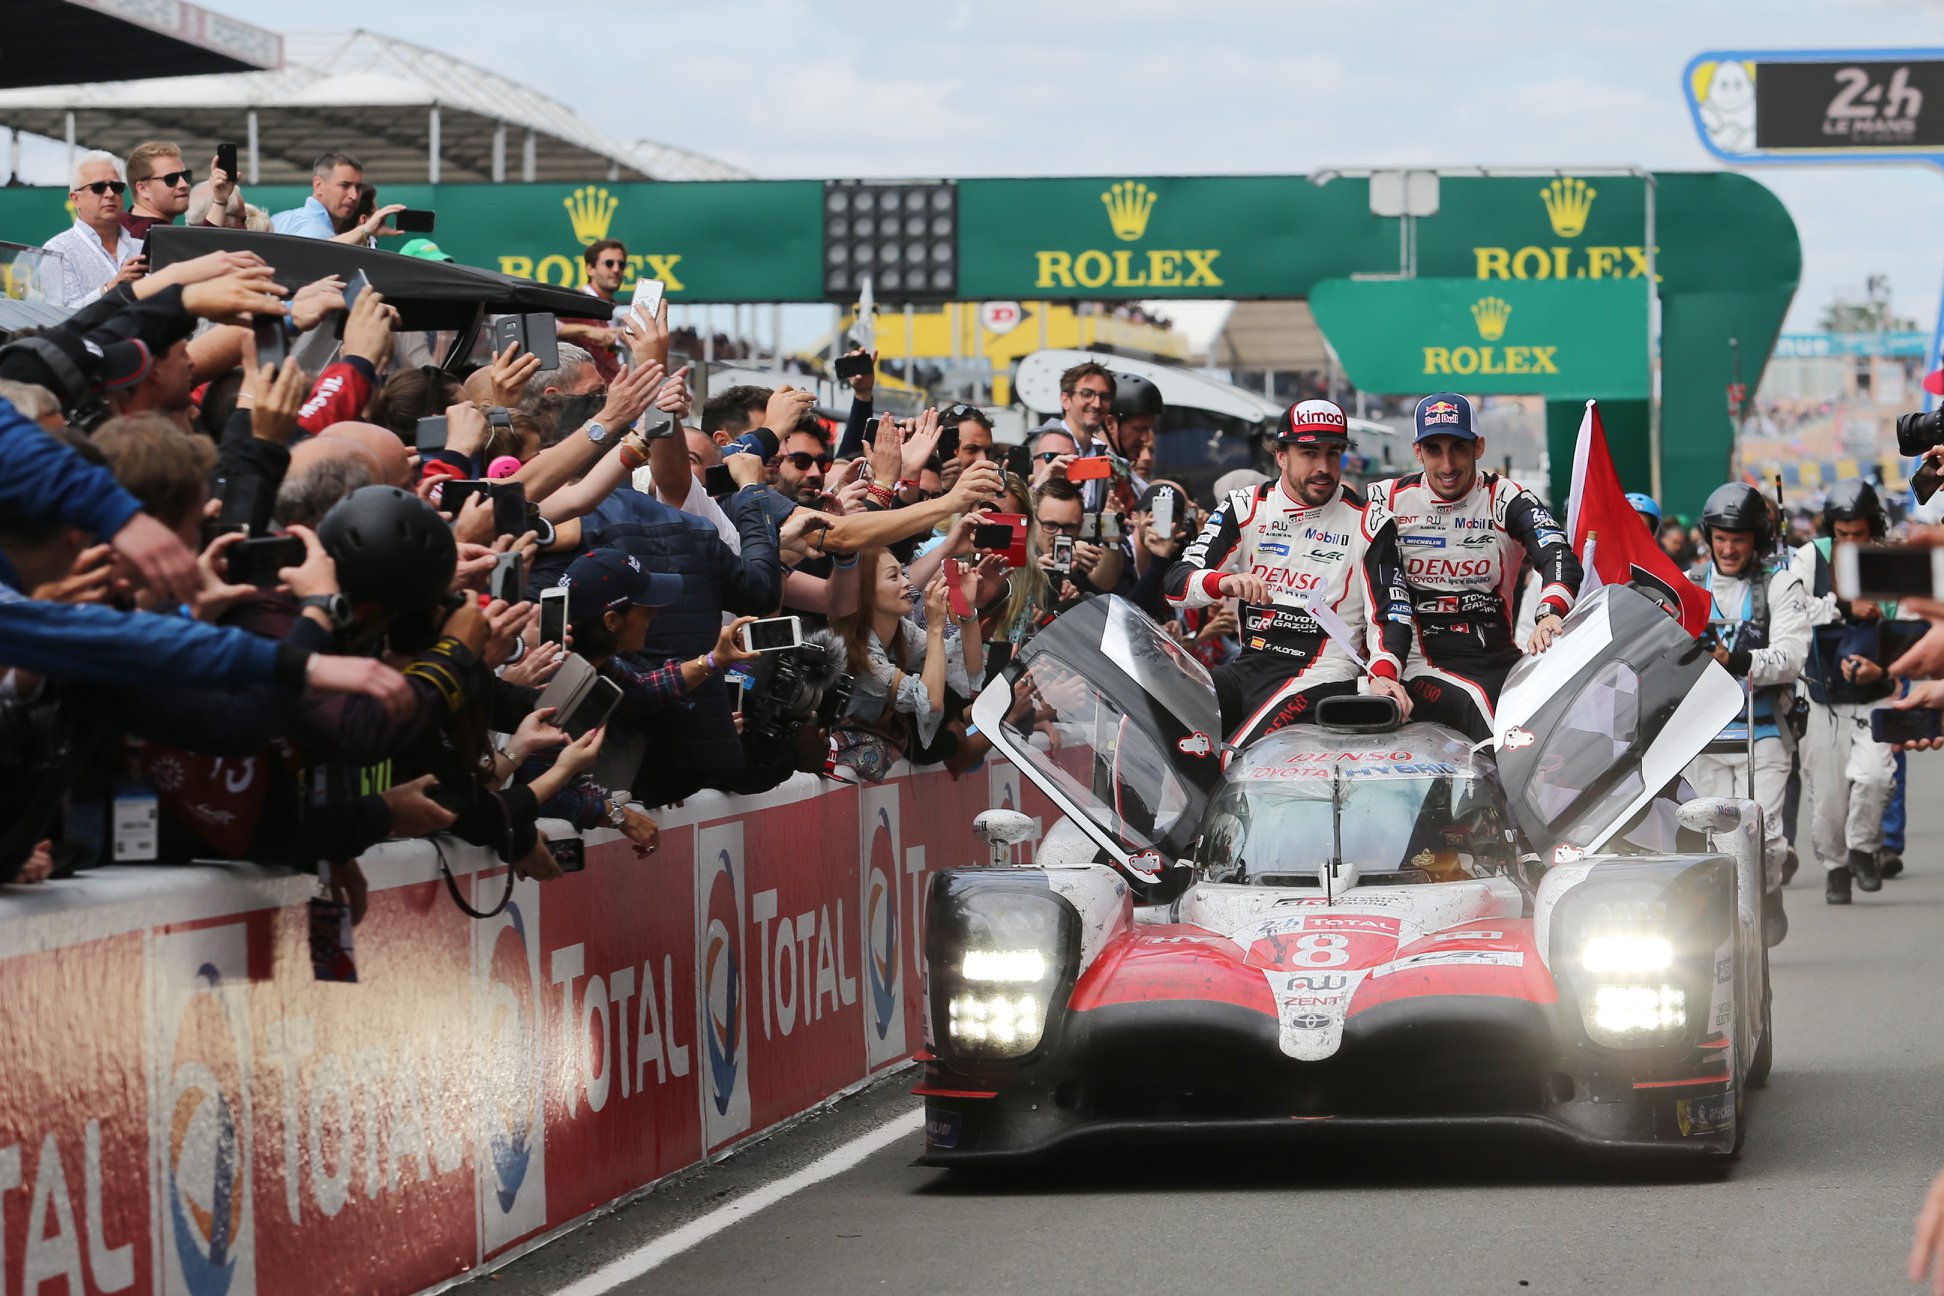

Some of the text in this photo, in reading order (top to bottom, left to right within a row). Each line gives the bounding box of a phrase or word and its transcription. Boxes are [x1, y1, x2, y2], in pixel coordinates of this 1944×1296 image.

[1034, 249, 1225, 288] ROLEX
[1422, 345, 1559, 375] ROLEX
[1296, 409, 1343, 426] kimoa
[1424, 414, 1459, 426] Red Bull
[1454, 517, 1486, 530] Mobil
[1304, 528, 1340, 545] Mobil
[1407, 558, 1491, 578] DENSO
[1407, 575, 1447, 584] TOYOTA
[1276, 610, 1319, 624] TOYOT
[1272, 645, 1306, 657] ALONSO
[1285, 750, 1414, 764] DENSO
[1247, 762, 1461, 779] TOYOTA HYBRID
[1308, 918, 1396, 932] TOTAL
[1291, 933, 1350, 968] 8
[753, 887, 857, 1042] TOTAL
[1283, 995, 1344, 1007] ZENT
[551, 941, 690, 1121] TOTAL
[264, 1016, 465, 1227] TOTAL
